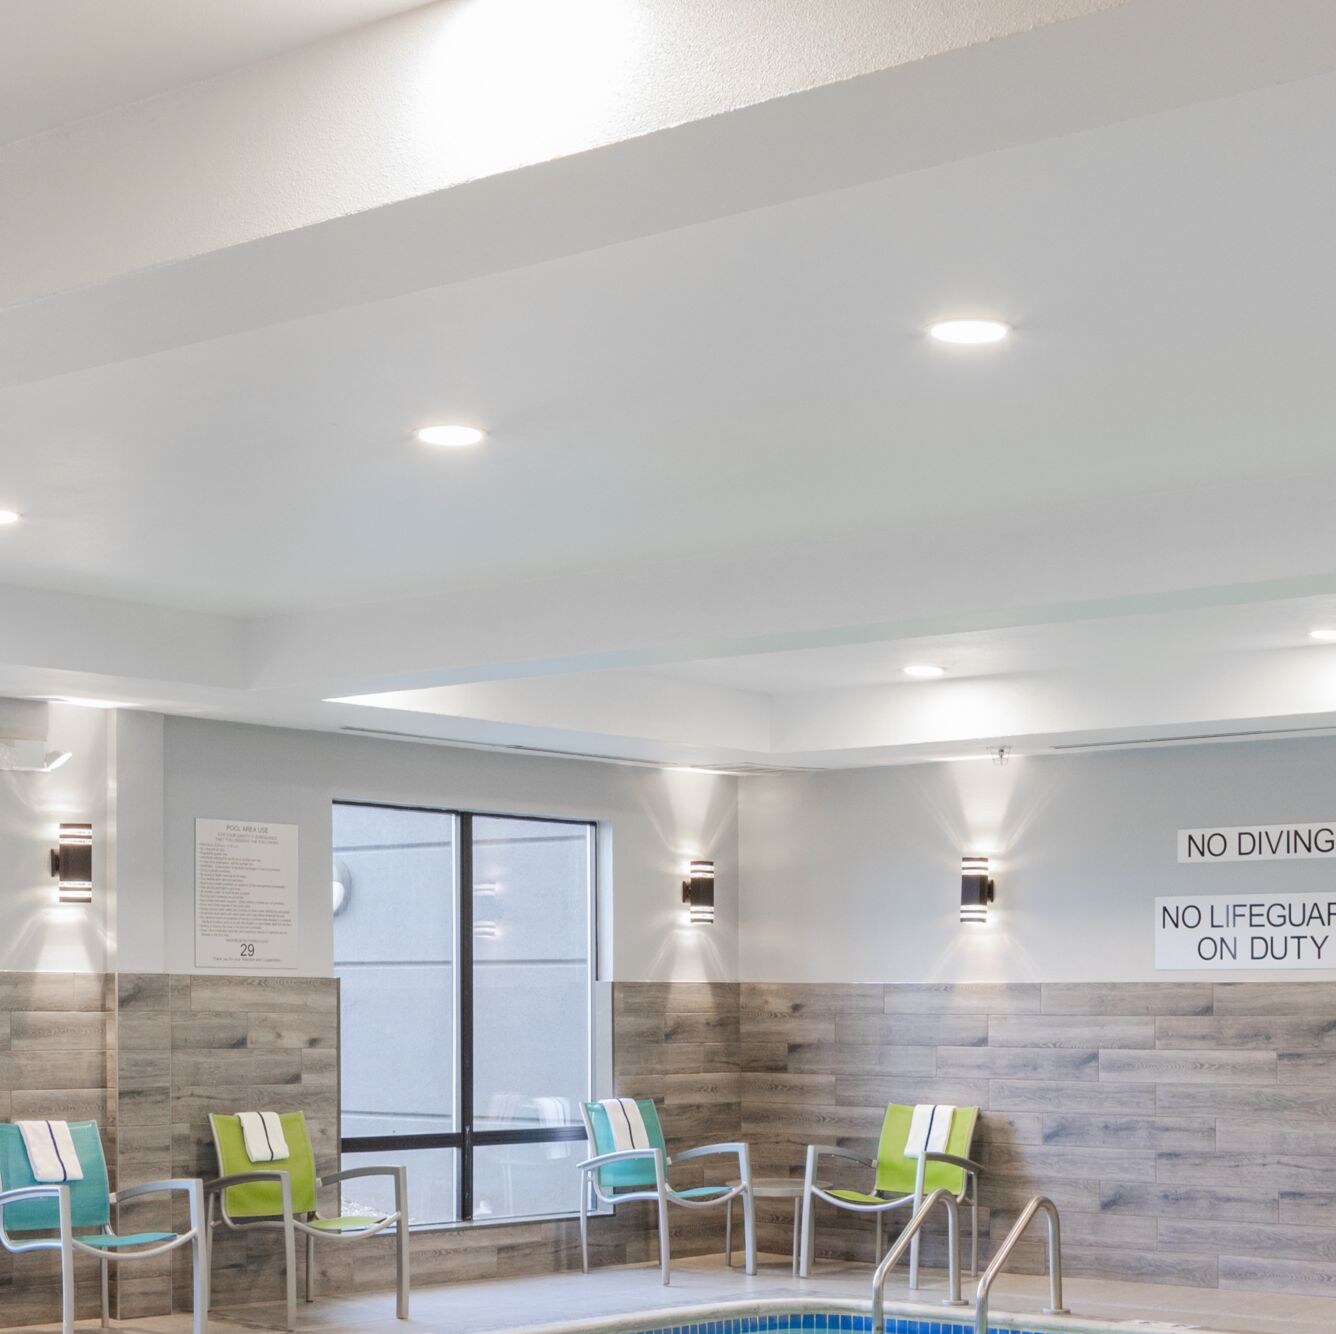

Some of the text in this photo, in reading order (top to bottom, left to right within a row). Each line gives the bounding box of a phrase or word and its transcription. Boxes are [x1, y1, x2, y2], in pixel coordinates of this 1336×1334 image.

[226, 824, 241, 832] POOL
[242, 825, 257, 833] AREA
[1188, 828, 1335, 858] NO DIVING
[1162, 904, 1202, 929] NO
[240, 943, 255, 957] 29
[1197, 935, 1329, 960] ON DUTY
